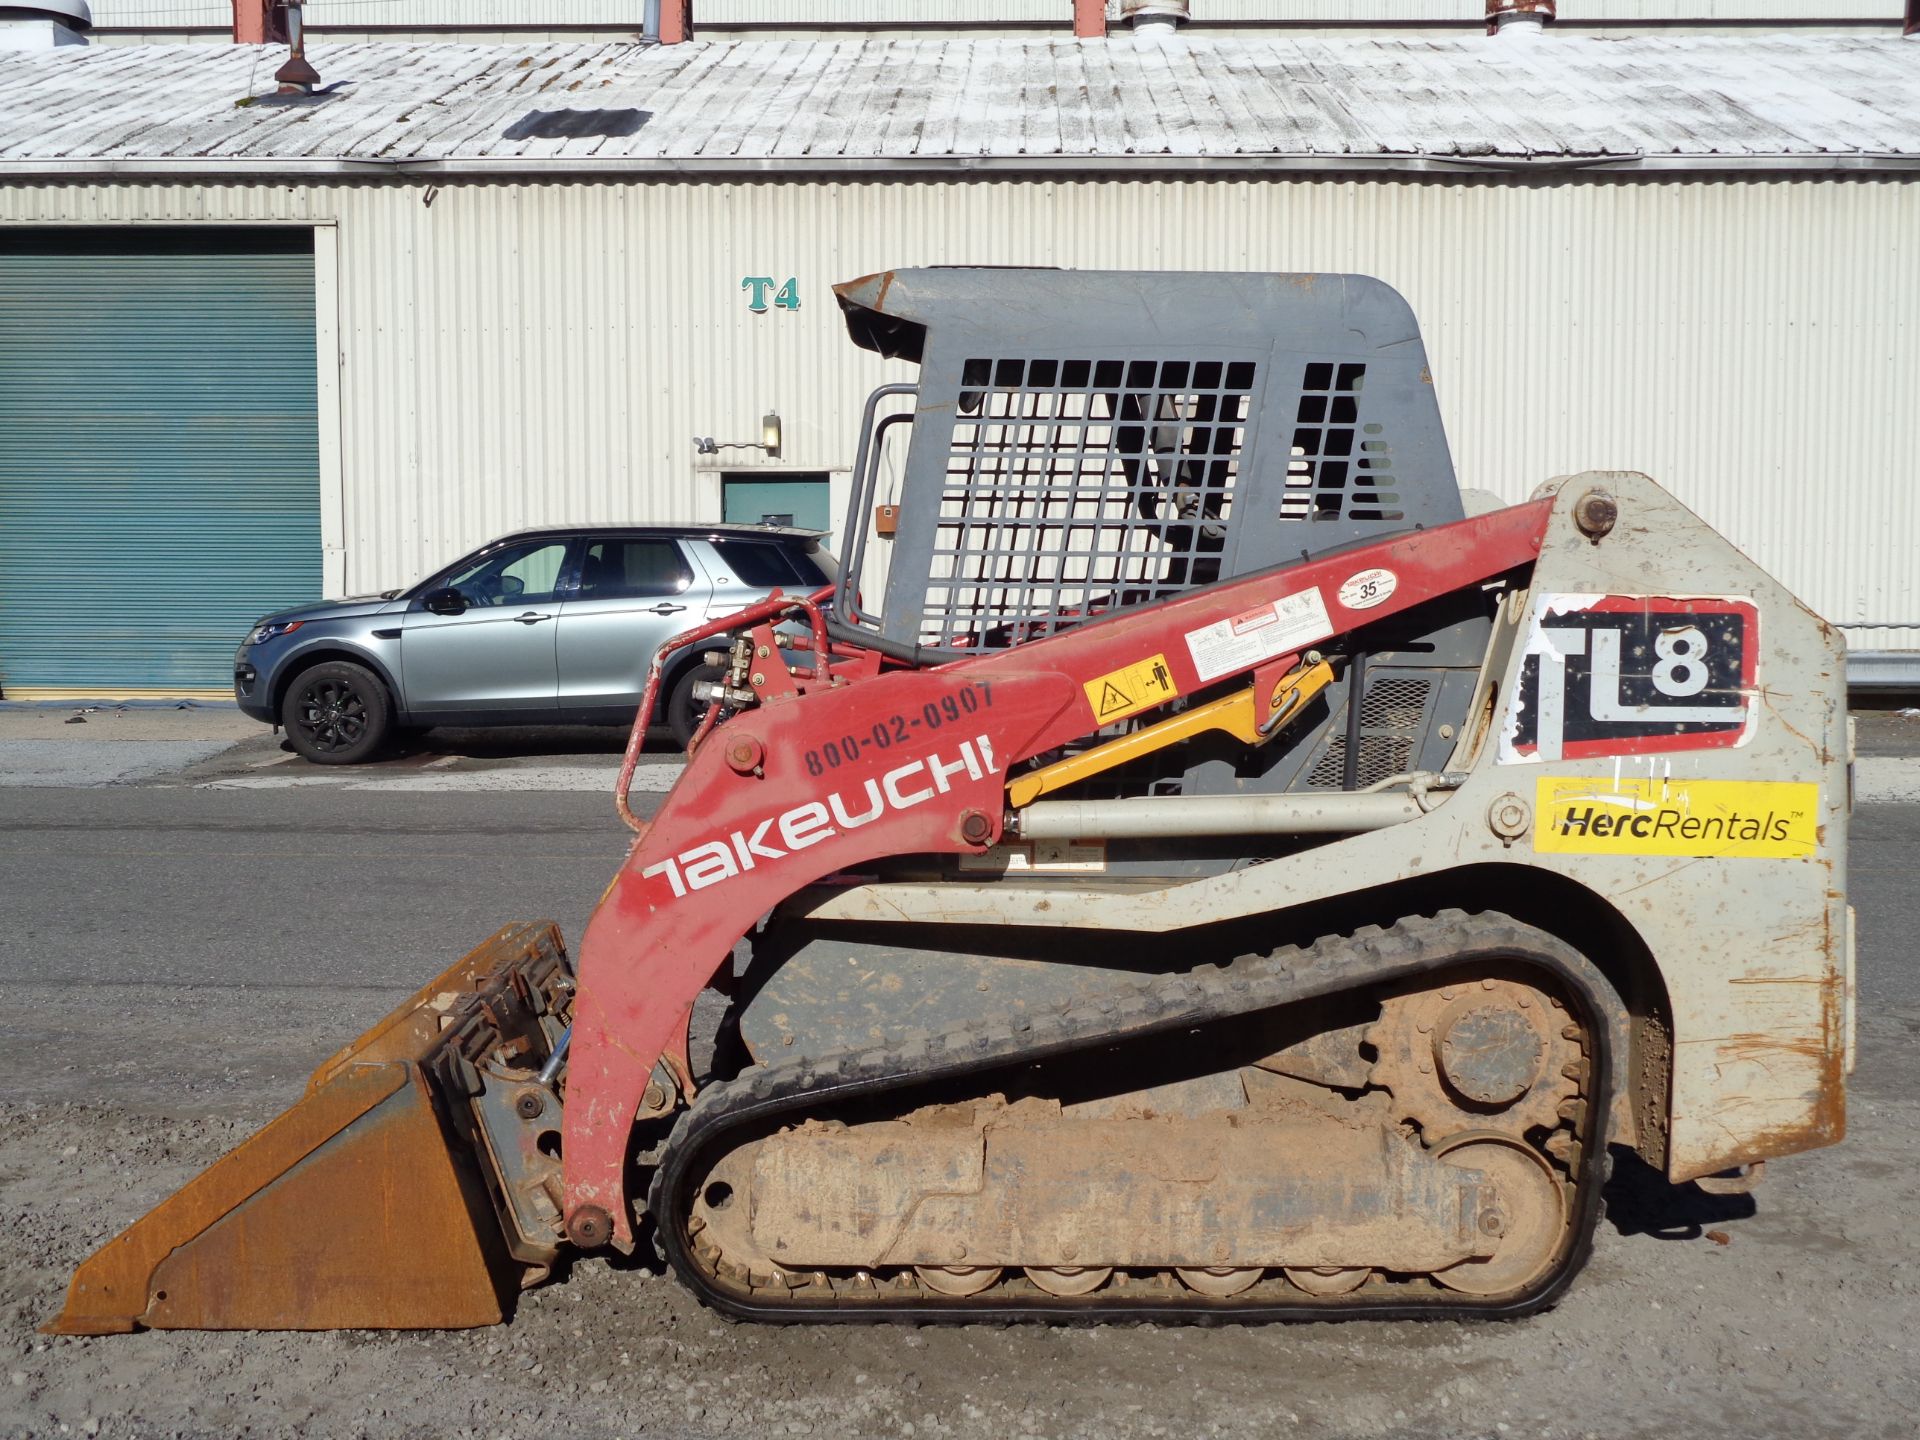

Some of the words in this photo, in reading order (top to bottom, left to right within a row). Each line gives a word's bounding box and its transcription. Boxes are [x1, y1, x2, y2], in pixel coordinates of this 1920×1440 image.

[741, 276, 801, 311] T4
[1360, 581, 1377, 599] 35
[805, 681, 993, 777] 800-02-0907
